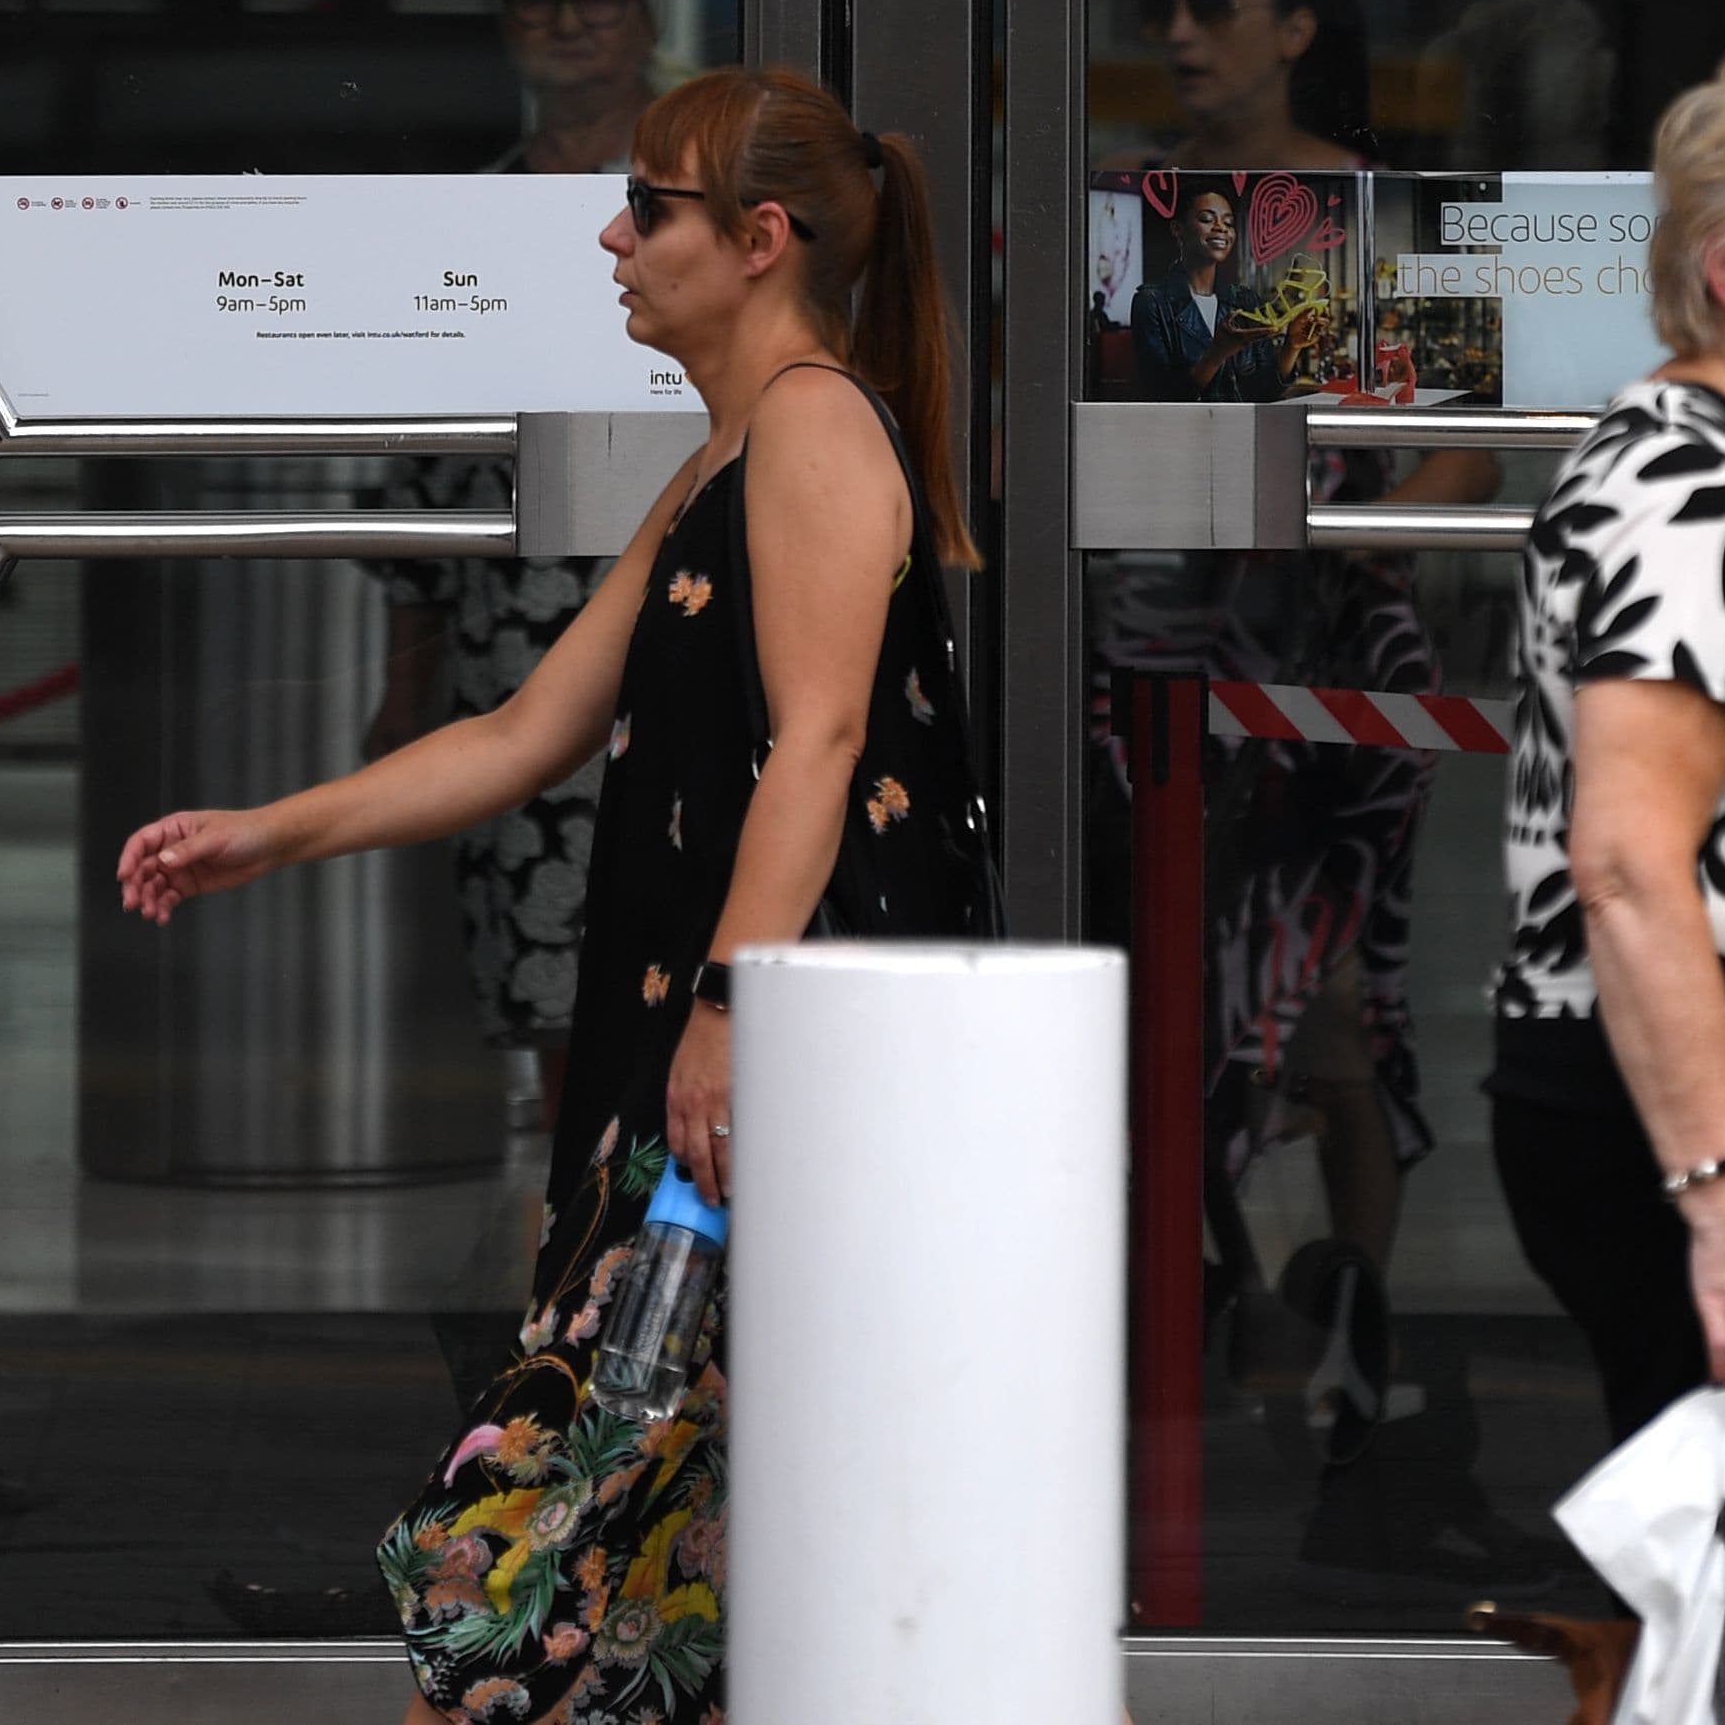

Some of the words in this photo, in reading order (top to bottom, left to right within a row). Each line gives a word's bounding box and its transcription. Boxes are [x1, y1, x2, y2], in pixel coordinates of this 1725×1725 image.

[1442, 205, 1598, 243] Because
[442, 270, 478, 288] Sun
[1399, 255, 1461, 294] the
[1475, 255, 1583, 294] shoes
[256, 331, 297, 339] Restaurants
[298, 332, 316, 340] open
[352, 331, 366, 339] visit
[430, 331, 441, 339] for
[649, 368, 683, 386] intu
